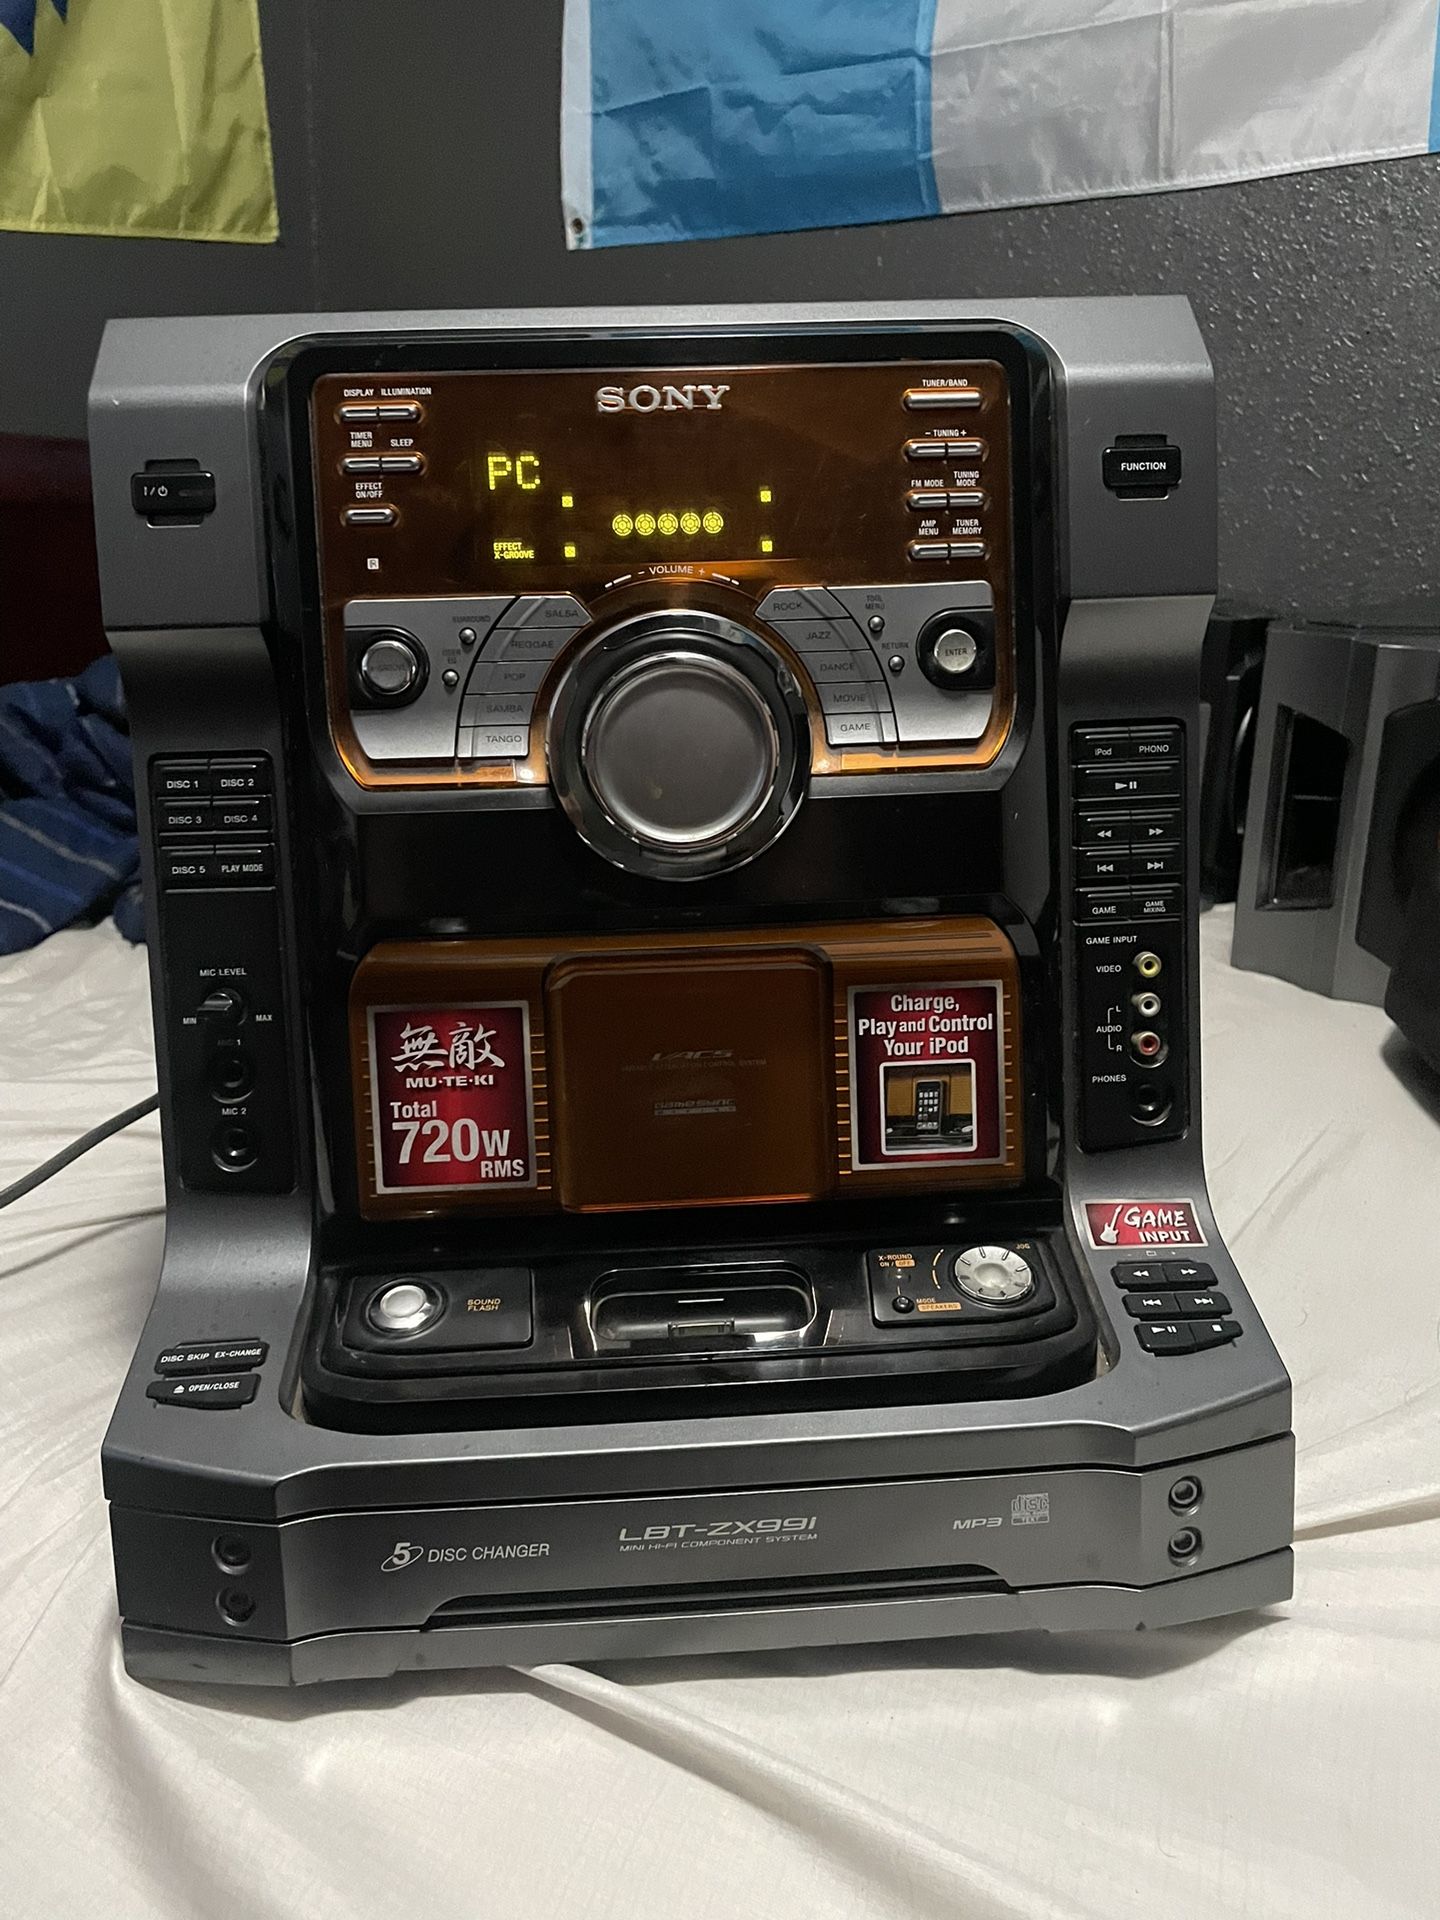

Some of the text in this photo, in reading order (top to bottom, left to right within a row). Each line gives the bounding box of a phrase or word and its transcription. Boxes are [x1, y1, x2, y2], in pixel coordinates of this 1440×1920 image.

[922, 378, 968, 387] TUNER/BAND
[343, 388, 374, 397] DISPLAY
[380, 387, 432, 396] ILLUMINATION
[596, 385, 731, 413] SONY
[350, 432, 373, 440] TIMER
[933, 429, 960, 437] TUNING
[350, 440, 373, 448] MENU
[390, 438, 414, 447] SLEEP
[1120, 462, 1167, 471] FUNCTION
[487, 455, 541, 490] PC
[953, 471, 980, 479] TUNING
[355, 482, 382, 490] EFFECT
[911, 479, 944, 488] FM MODE
[956, 478, 976, 486] MODE
[355, 490, 383, 498] ON/OFF
[920, 520, 937, 528] AMP
[956, 519, 979, 527] TUNER
[918, 528, 939, 536] MENU
[952, 527, 982, 535] MEMORY
[493, 542, 522, 550] EFFECT
[494, 550, 535, 560] X-GROOVE
[648, 566, 694, 576] VOLUME
[773, 602, 803, 611] ROCK
[545, 609, 579, 618] SALSA
[806, 631, 832, 640] JAZZ
[511, 640, 554, 649] REGGAE
[881, 642, 909, 650] RETURN
[944, 648, 968, 656] ENTER
[820, 663, 856, 672] DANCE
[504, 672, 526, 681] POP
[833, 694, 866, 703] MOVIE
[486, 704, 524, 713] SAMBA
[840, 722, 871, 732] GAME
[486, 734, 522, 743] TANGO
[1094, 748, 1112, 756] iPod
[1138, 745, 1169, 753] PHONO
[166, 780, 199, 788] DISC 1
[220, 778, 254, 788] DISC 2
[168, 816, 202, 824] DISC 3
[224, 814, 258, 824] DISC 4
[172, 866, 206, 874] DISC 5
[222, 864, 264, 873] PLAY MODE
[1092, 906, 1116, 914] GAME
[1144, 906, 1166, 914] MIXING
[1086, 936, 1138, 945] GAME INPUT
[200, 968, 247, 977] MIC LEVEL
[1096, 965, 1122, 973] VIDEO
[890, 994, 960, 1014] Charge,
[182, 1017, 197, 1025] MIN
[256, 1014, 272, 1022] MAX
[858, 1013, 994, 1038] Play and Control
[1096, 1024, 1122, 1033] AUDIO
[390, 1021, 506, 1073] 無敵
[883, 1036, 969, 1056] Your iPod
[1116, 1044, 1122, 1052] R
[1092, 1074, 1127, 1084] PHONES
[222, 1108, 247, 1116] MIC 2
[389, 1100, 438, 1119] Total
[480, 1158, 526, 1178] RMS
[1124, 1206, 1188, 1228] GAME
[1138, 1230, 1190, 1242] INPUT
[466, 1298, 501, 1306] SOUND
[160, 1352, 210, 1363] DISC SKIP
[214, 1348, 262, 1359] EX-CHANGE
[188, 1381, 240, 1392] OPEN/CLOSE
[952, 1517, 1003, 1530] MP3
[620, 1533, 818, 1552] MINI HI-FI COMPONENT SYSTEM
[392, 1542, 550, 1566] 5 DISC CHANGER
